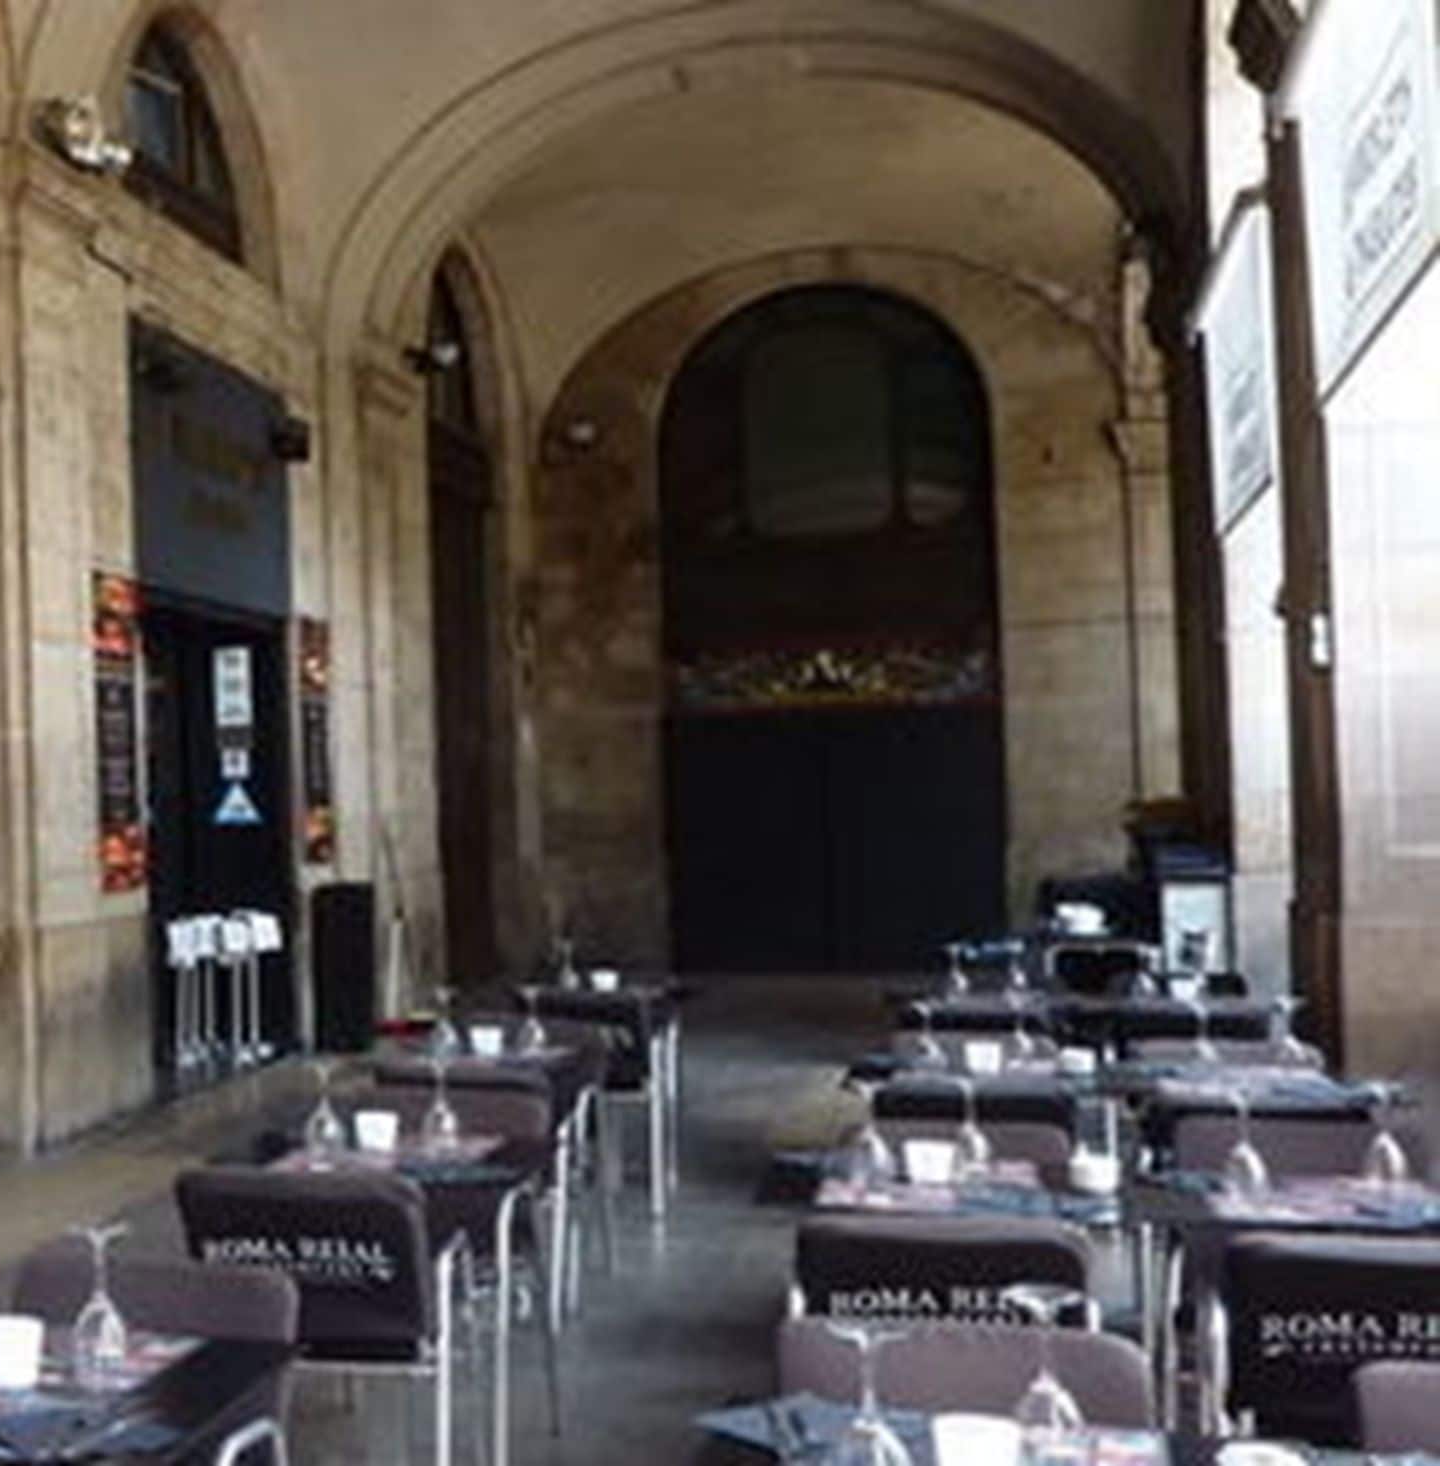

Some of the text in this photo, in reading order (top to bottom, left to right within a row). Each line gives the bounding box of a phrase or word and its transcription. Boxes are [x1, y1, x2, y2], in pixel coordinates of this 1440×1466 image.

[202, 1236, 293, 1264] ROMA
[829, 1288, 941, 1317] ROMA
[1260, 1311, 1385, 1343] ROMA
